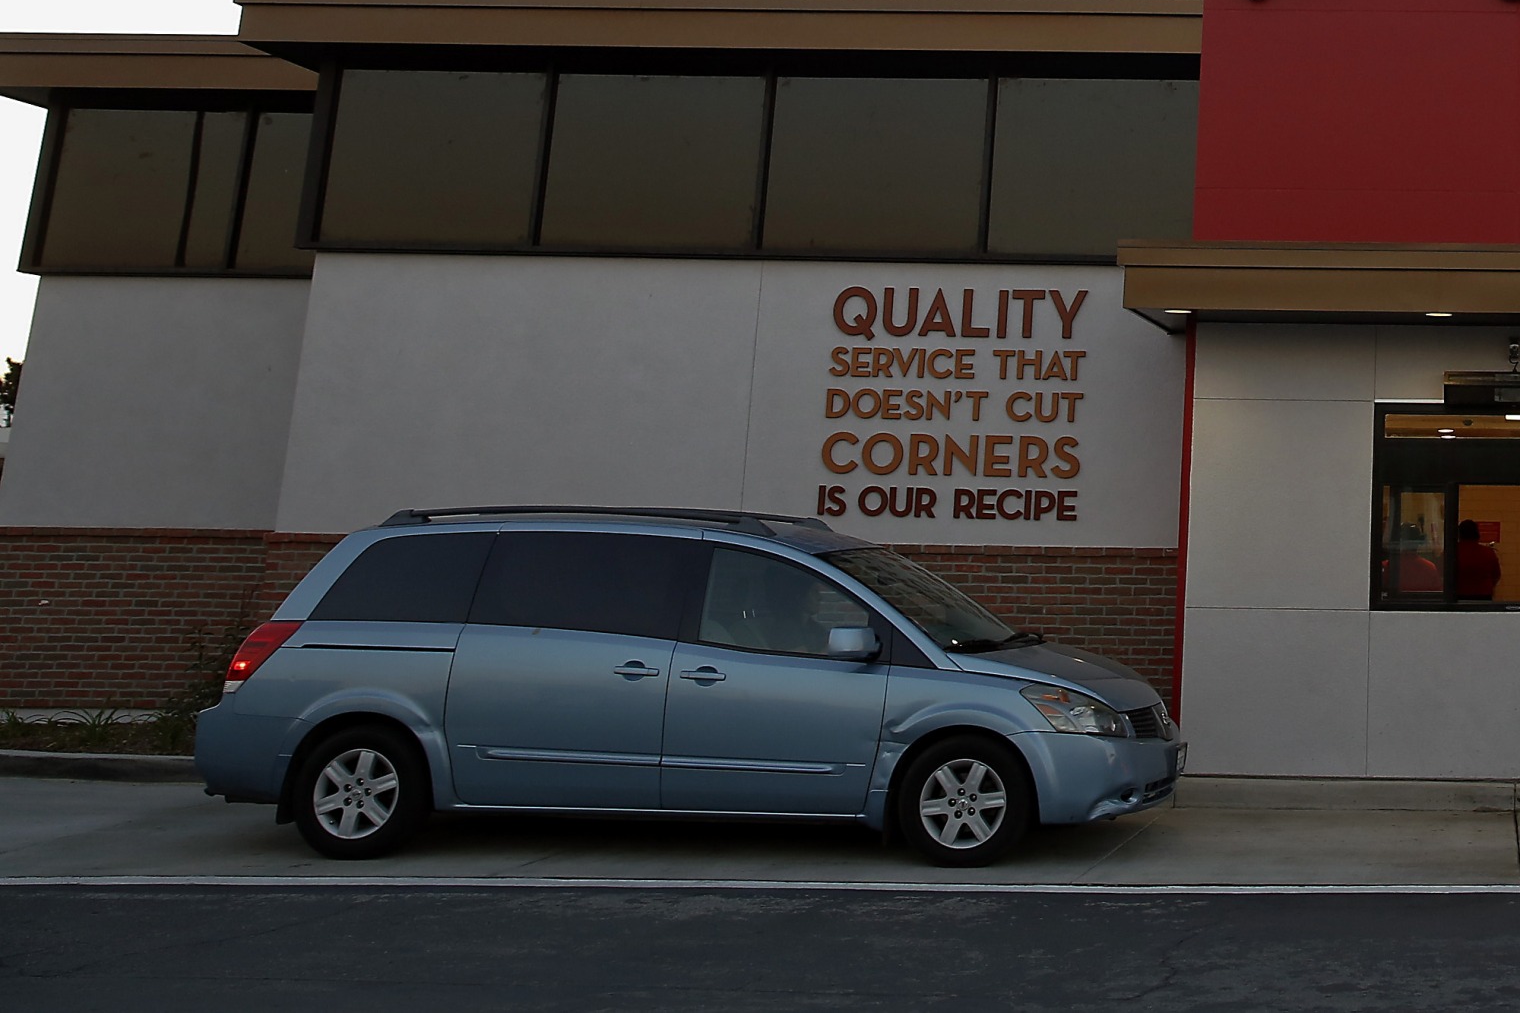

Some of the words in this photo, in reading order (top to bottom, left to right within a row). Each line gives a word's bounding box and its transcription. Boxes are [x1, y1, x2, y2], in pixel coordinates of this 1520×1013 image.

[833, 286, 1089, 341] QUALITY
[829, 347, 976, 379] SERVICE
[993, 349, 1087, 380] THAT
[825, 388, 989, 421] DOESN'T
[1005, 391, 1084, 422] CUT
[821, 432, 1081, 479] CORNERS
[817, 485, 847, 517] IS
[858, 485, 937, 519] OUR
[953, 488, 1078, 521] RECIPE
